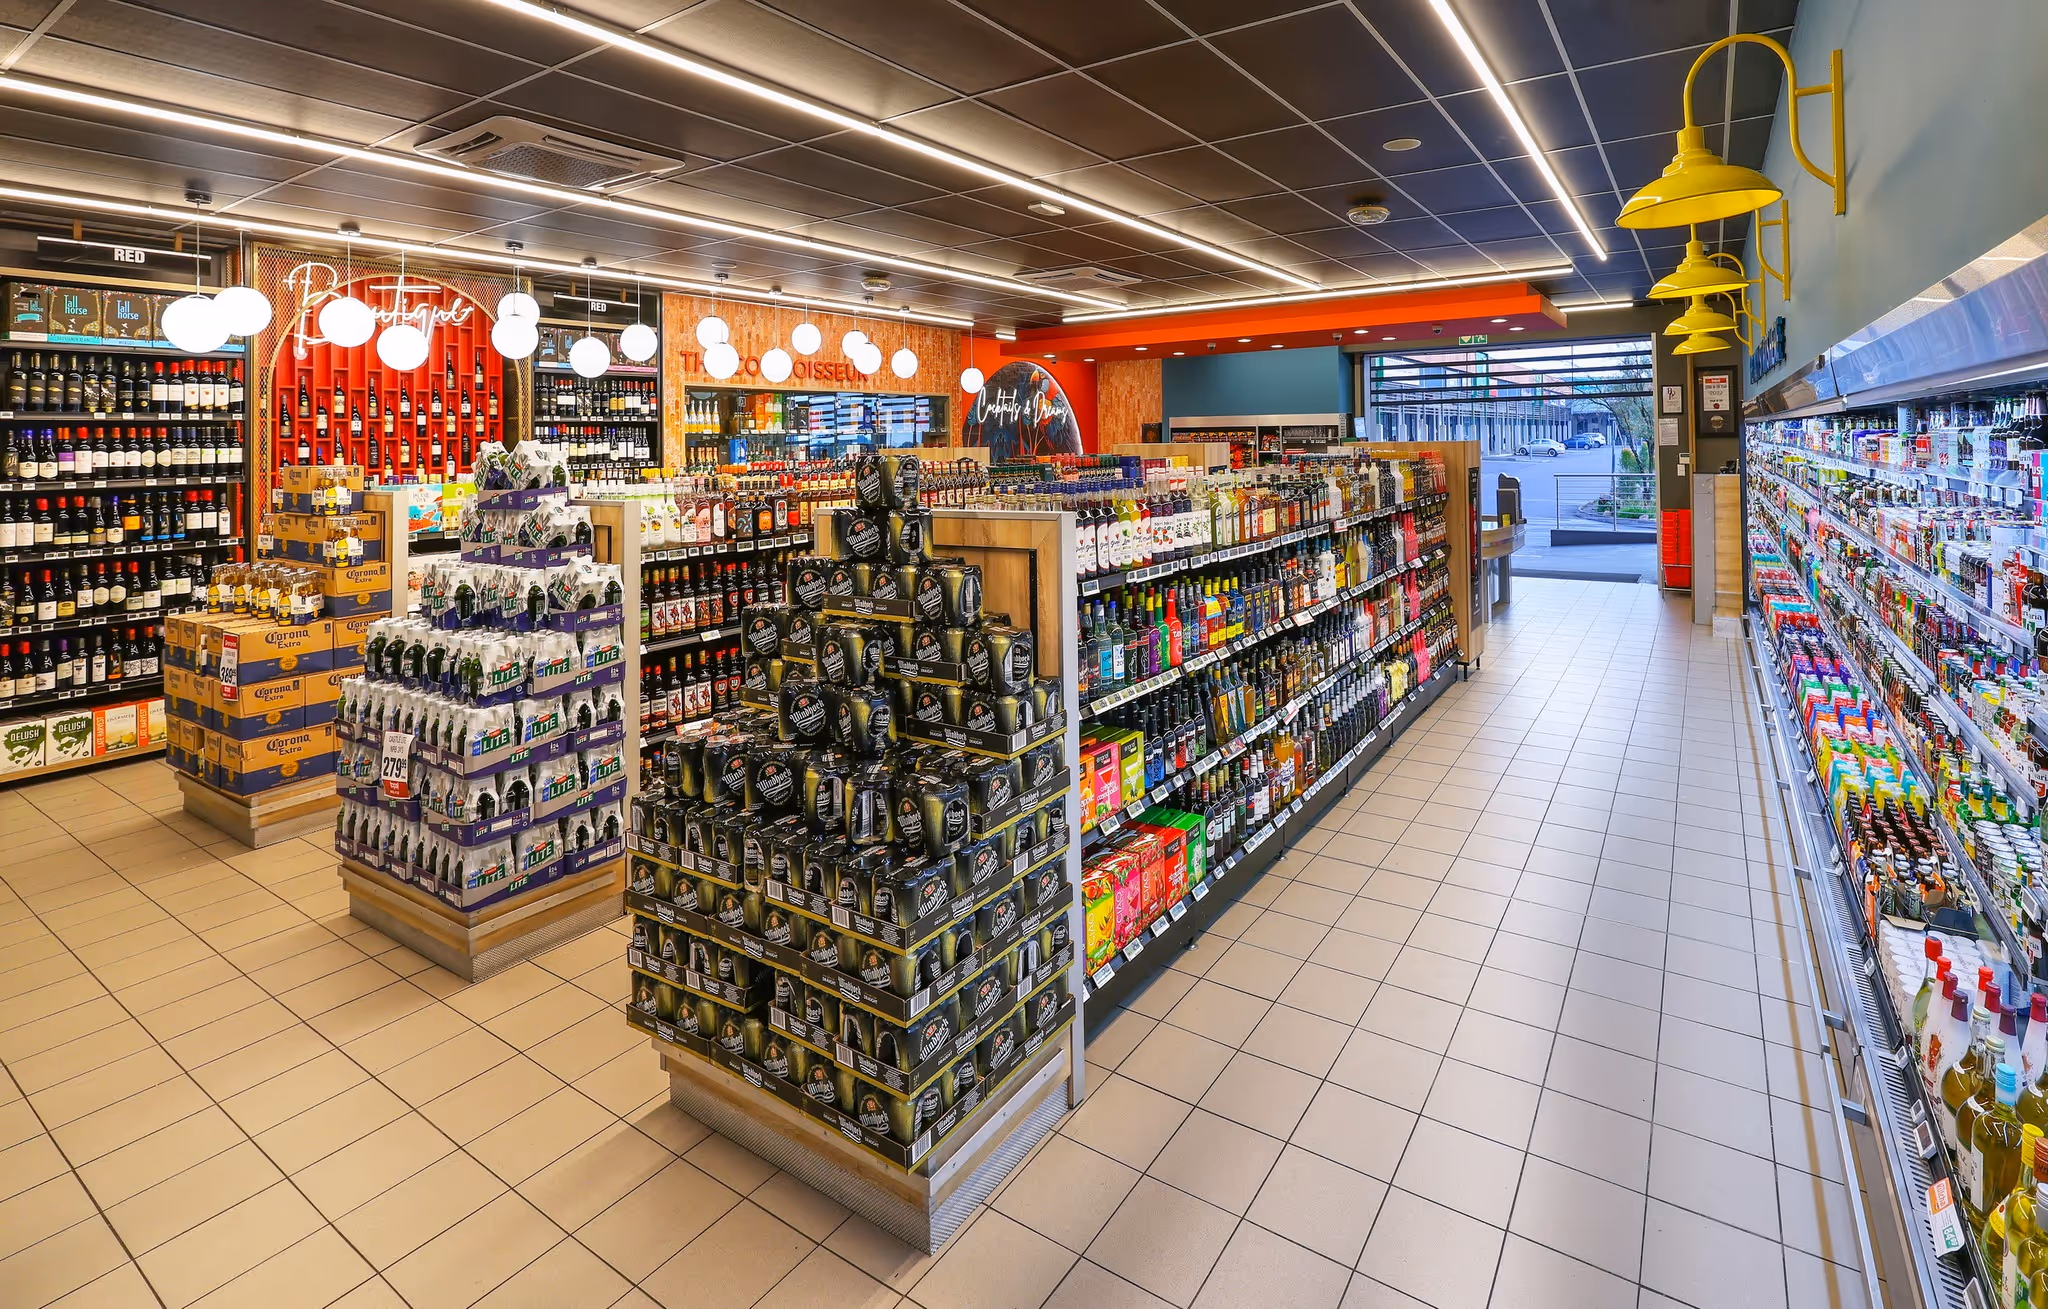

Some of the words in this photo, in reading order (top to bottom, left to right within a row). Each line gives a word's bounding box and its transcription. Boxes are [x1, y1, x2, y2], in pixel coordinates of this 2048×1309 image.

[114, 248, 146, 264] RED
[64, 294, 78, 308] Tall
[65, 306, 87, 315] horse
[117, 300, 130, 312] Tall
[283, 260, 474, 358] Butique
[590, 302, 606, 312] RED
[118, 310, 139, 320] horse
[977, 386, 1022, 426] Cocktails
[1032, 391, 1069, 427] Dreams
[846, 525, 880, 545] Windhoek
[346, 564, 379, 578] Corona
[795, 578, 827, 599] Windhoek
[917, 585, 943, 606] Windhoek
[265, 629, 311, 645] Corona
[748, 623, 778, 644] Windhoek
[277, 640, 301, 649] Extra
[915, 637, 941, 660] Windhoek
[596, 650, 617, 664] LITE
[822, 649, 844, 669] Windhoek
[968, 648, 989, 669] Windhoek
[494, 670, 518, 684] LITE
[545, 662, 568, 676] LITE
[576, 673, 592, 684] LITE
[254, 685, 292, 699] Corona
[789, 699, 825, 724] Windhoek
[916, 701, 942, 718] Windhoek
[59, 721, 86, 733] DELUSH
[534, 715, 558, 737] LITE
[967, 711, 996, 730] Windhoek
[10, 729, 39, 742] DELUSH
[266, 733, 311, 752] Corona
[482, 732, 510, 751] LITE
[278, 745, 302, 756] Extra
[511, 749, 530, 764] LITE
[597, 759, 620, 779] LITE
[550, 778, 574, 798] LITE
[756, 767, 792, 791] Windhoek
[576, 793, 594, 807] LITE
[987, 782, 1011, 811] Windhoek
[897, 808, 921, 827] Windhoek
[530, 844, 553, 865] LITE
[972, 850, 998, 884] Windhoek
[510, 877, 529, 892] LITE
[918, 880, 948, 917] Windhoek
[991, 901, 1017, 936] Windhoek
[861, 963, 890, 982] Windhoek
[975, 981, 1002, 1017] Windhoek
[918, 1018, 949, 1062] Windhoek
[859, 1112, 889, 1128] Windhoek
